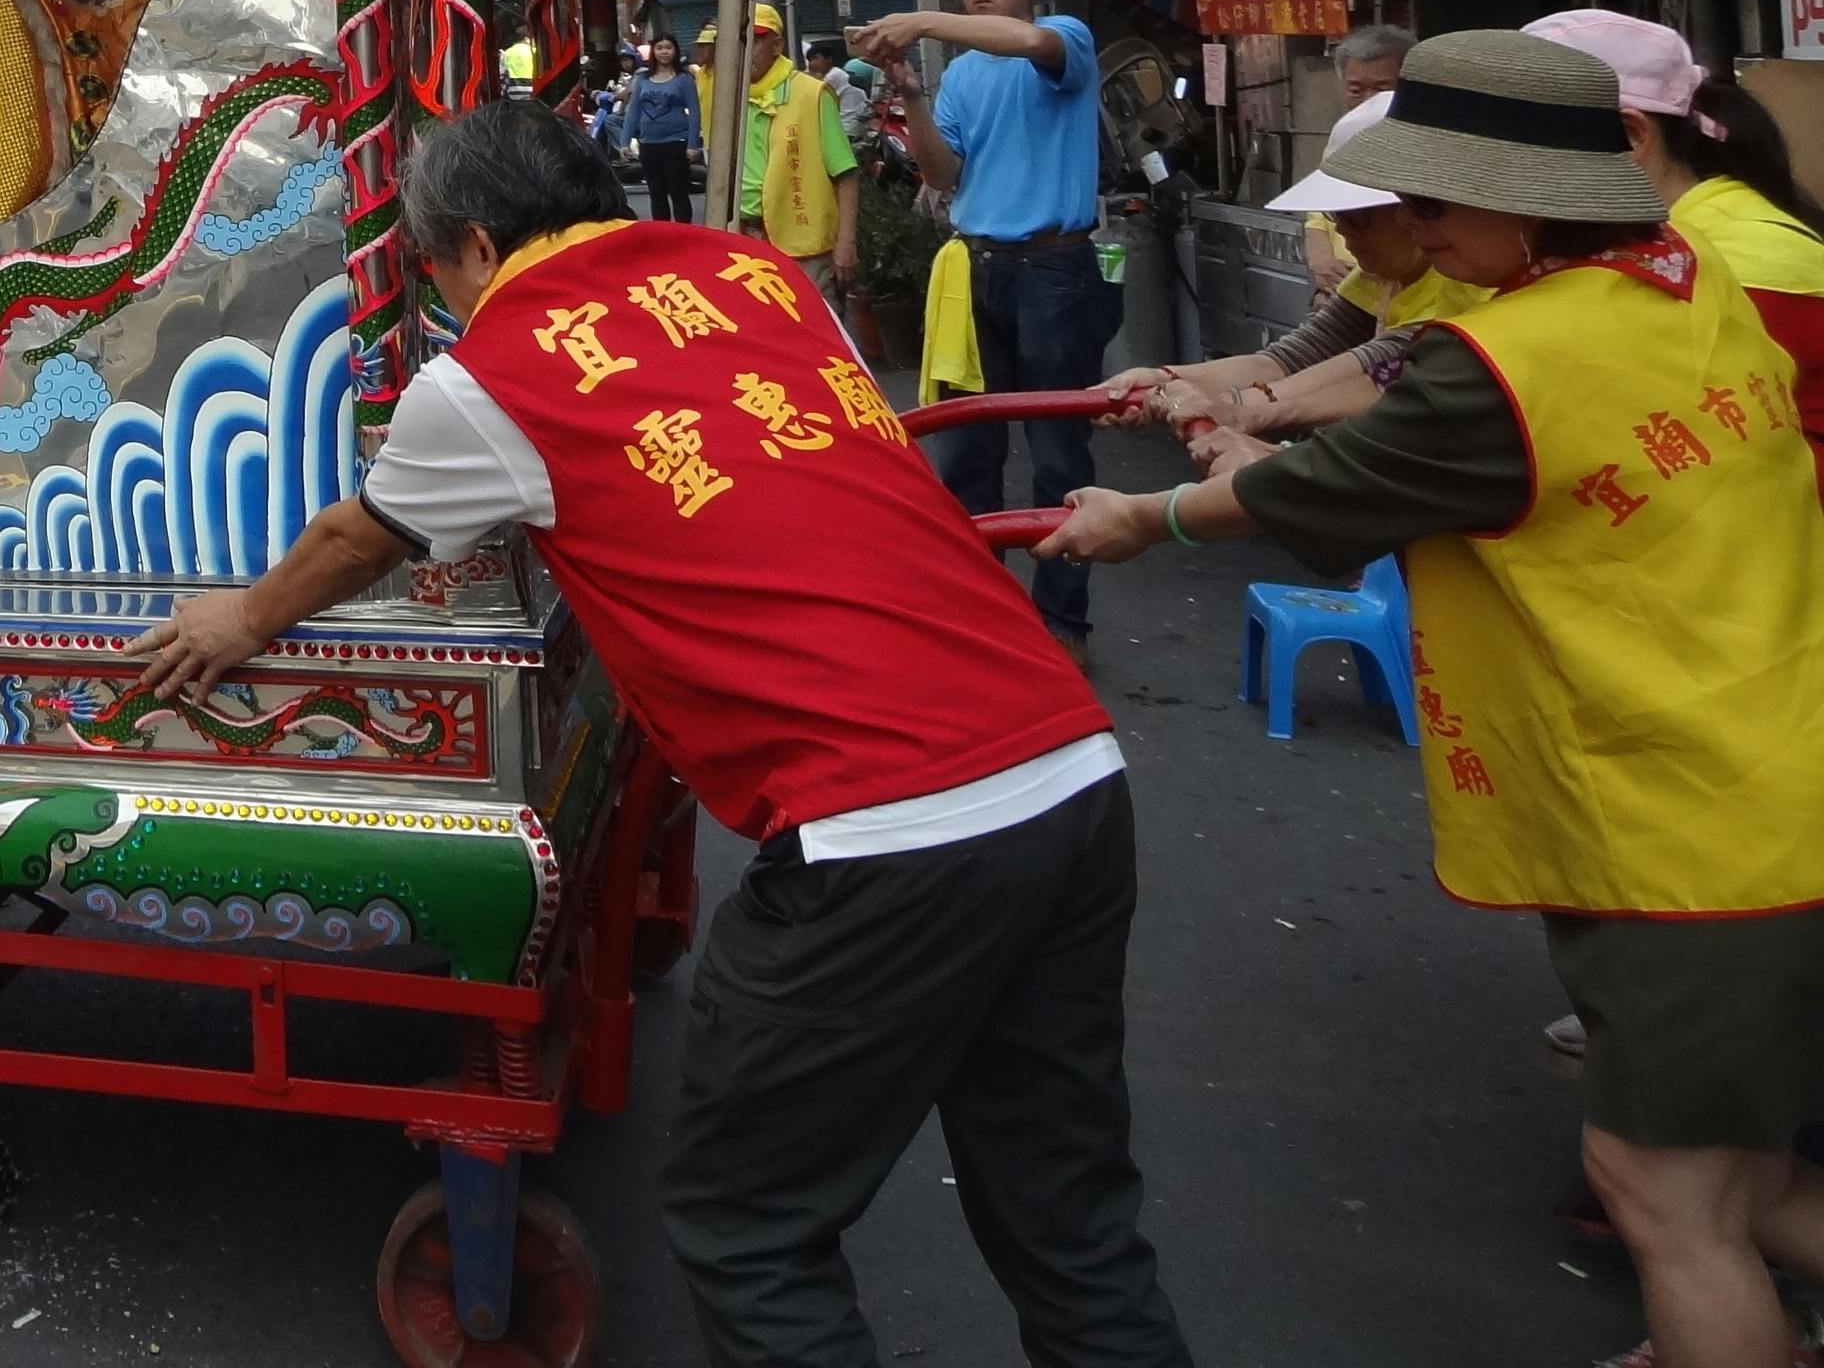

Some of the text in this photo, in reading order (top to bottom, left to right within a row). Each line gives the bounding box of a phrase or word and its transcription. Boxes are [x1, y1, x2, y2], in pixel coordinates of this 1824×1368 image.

[531, 251, 801, 394] 宜蘭市
[623, 355, 908, 519] 靈惠廟
